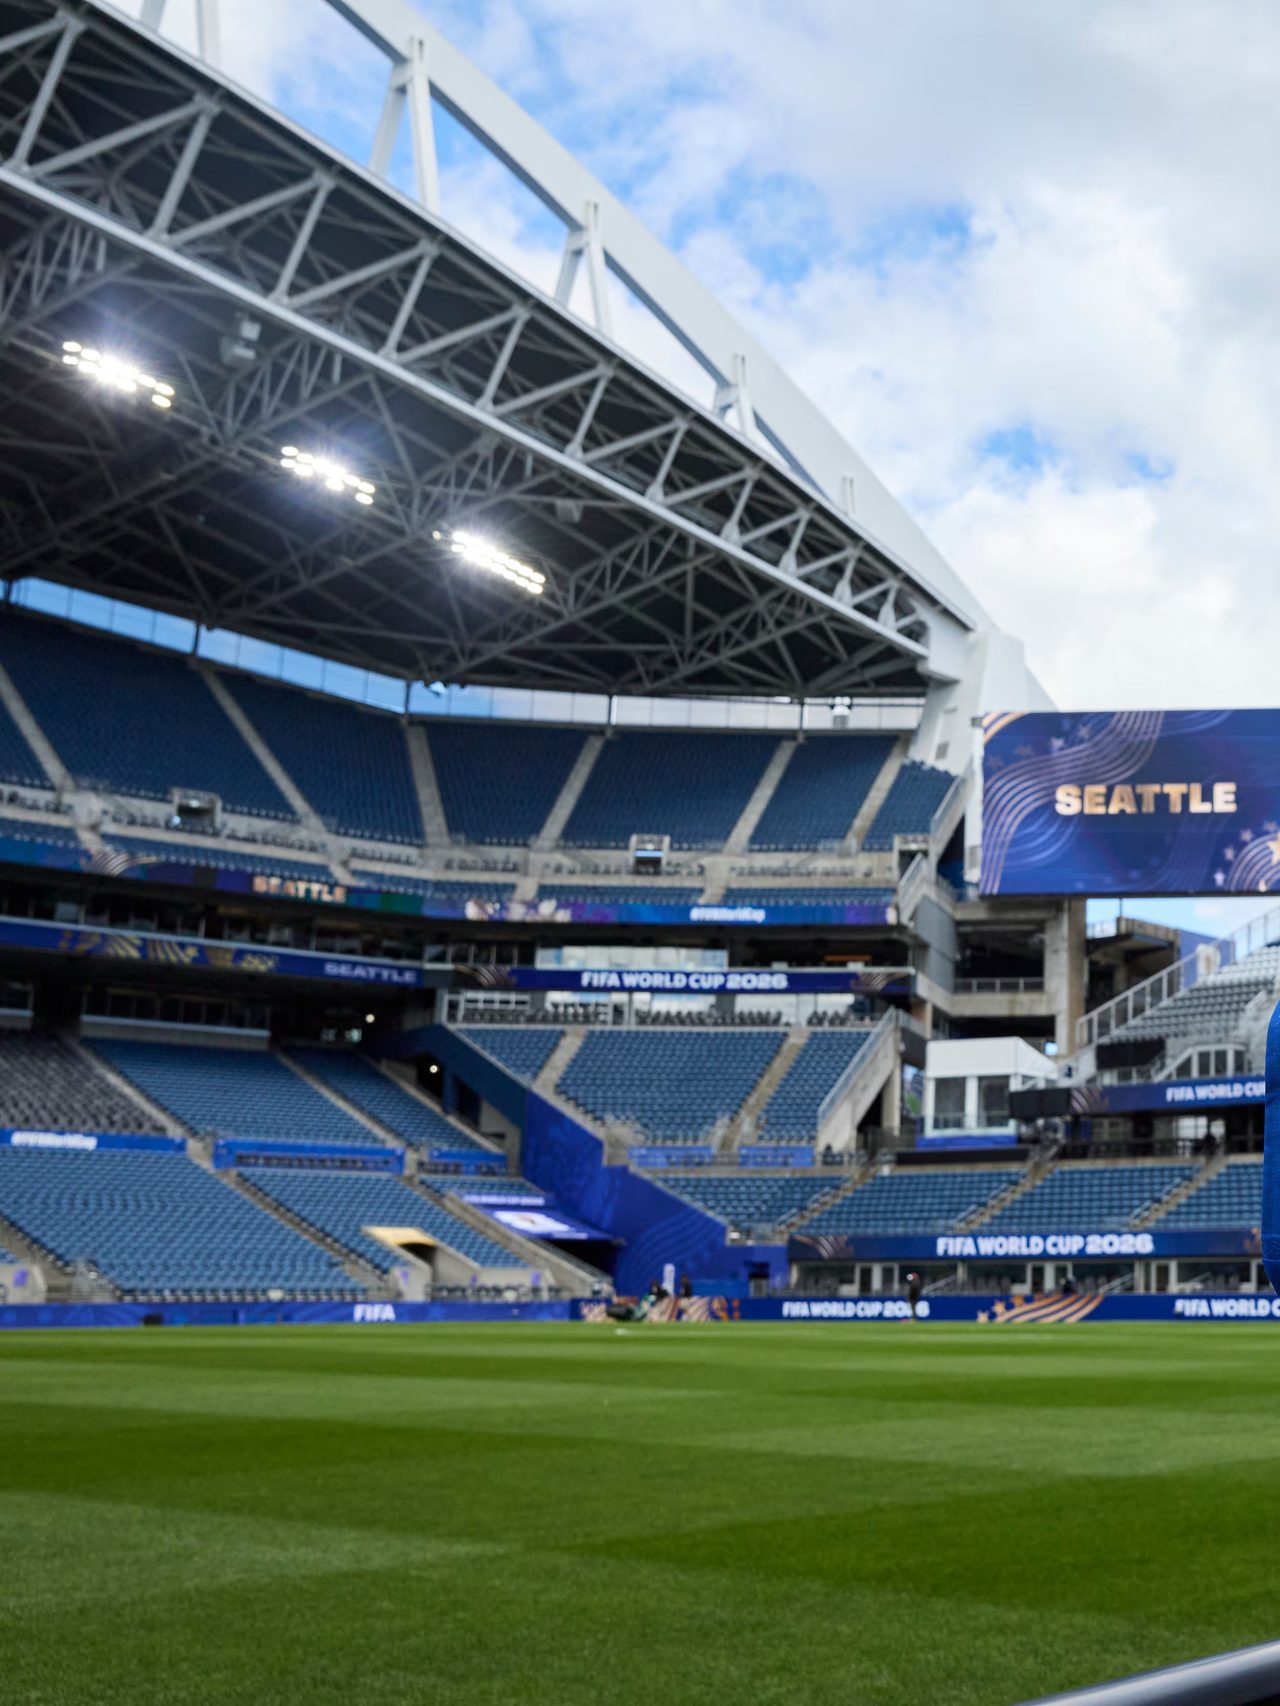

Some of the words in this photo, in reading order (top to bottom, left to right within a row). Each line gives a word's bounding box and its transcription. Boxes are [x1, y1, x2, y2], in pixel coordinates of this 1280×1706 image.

[1055, 782, 1237, 815] SEATTLE
[253, 876, 346, 903] SEATTLE
[324, 962, 416, 984] SEATTLE
[581, 972, 621, 988] FIFA
[621, 972, 689, 989] WORLD
[688, 973, 724, 989] CUP
[726, 973, 788, 989] 2026
[1166, 1086, 1195, 1102] FIFA
[1195, 1083, 1243, 1100] WORLD
[936, 1237, 977, 1256] FIFA
[976, 1236, 1044, 1256] WORLD
[1045, 1235, 1084, 1255] CUP
[1085, 1233, 1154, 1254] 2026
[353, 1303, 396, 1322] FIFA
[782, 1301, 811, 1318] FIFA
[810, 1301, 855, 1318] WORLD
[856, 1301, 883, 1318] CUP
[1174, 1299, 1210, 1317] FIFA
[1211, 1299, 1271, 1317] WORLD
